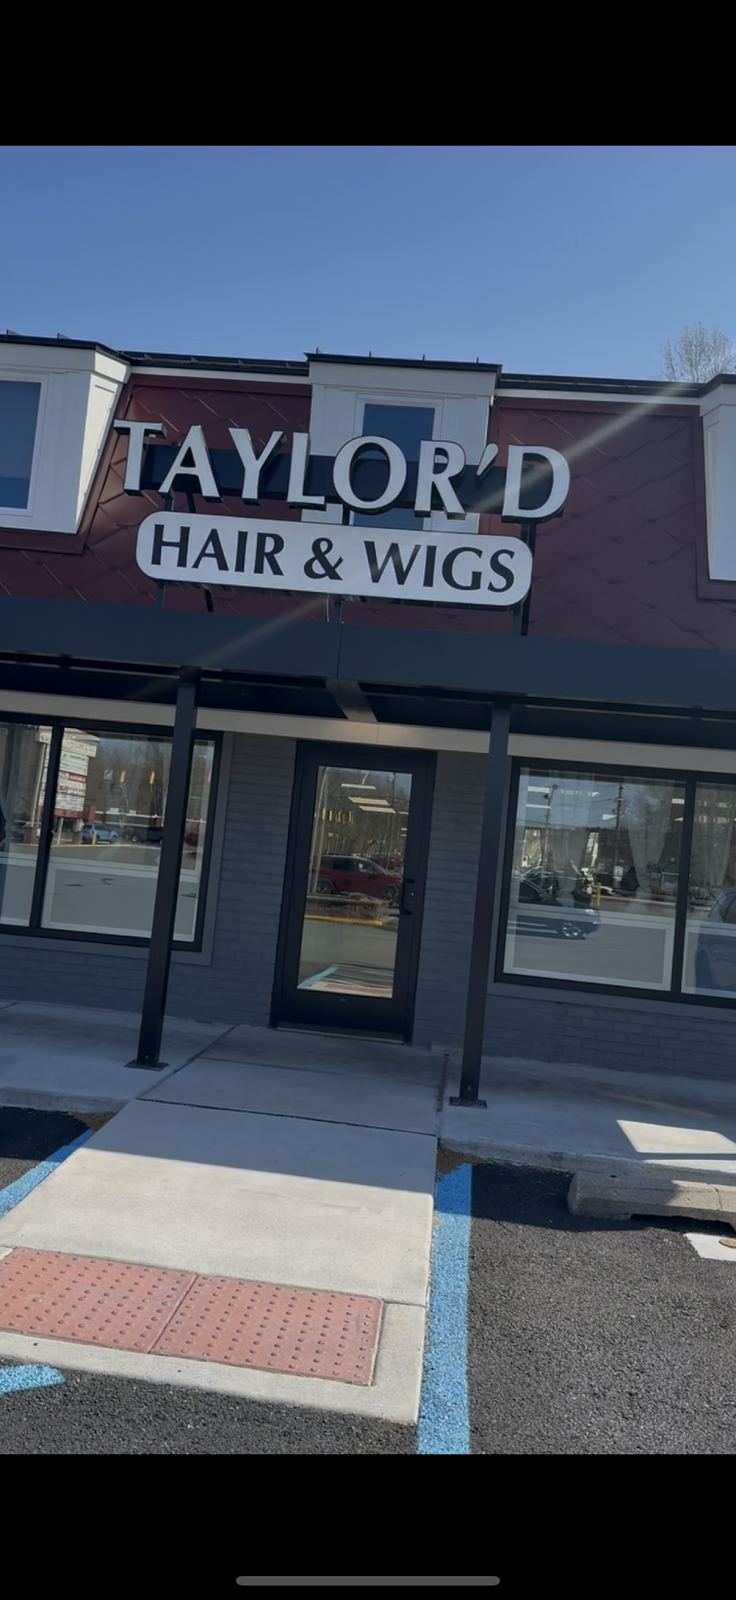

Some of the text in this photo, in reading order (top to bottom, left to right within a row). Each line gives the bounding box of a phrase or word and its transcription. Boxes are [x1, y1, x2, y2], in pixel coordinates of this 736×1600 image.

[113, 419, 571, 519] TAYLOR'D
[151, 524, 515, 593] HAIR & WIGS
